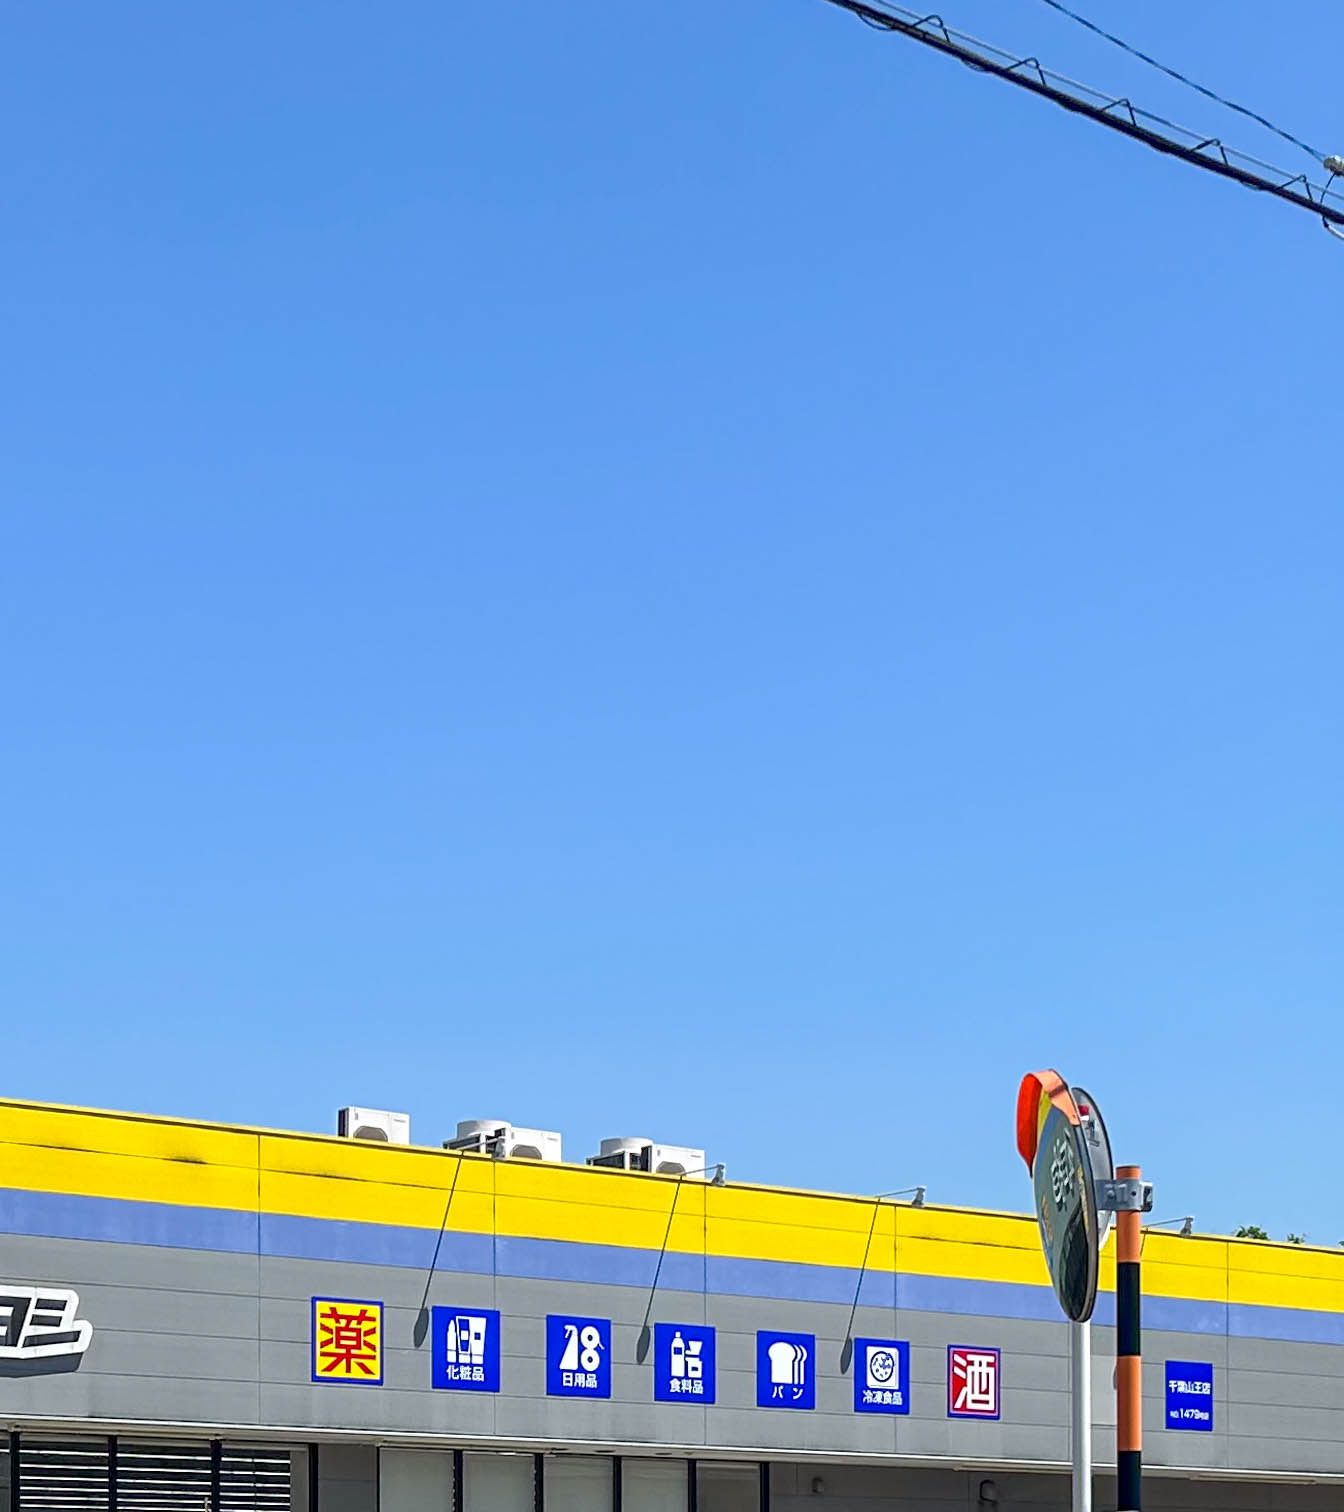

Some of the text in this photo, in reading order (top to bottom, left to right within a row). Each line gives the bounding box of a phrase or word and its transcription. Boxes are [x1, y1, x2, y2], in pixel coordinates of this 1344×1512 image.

[319, 1306, 377, 1376] 薬
[446, 1365, 485, 1382] 化粧品
[562, 1372, 598, 1389] 日用品
[953, 1353, 996, 1411] 酒
[669, 1378, 704, 1395] 食料品
[772, 1386, 804, 1400] パン
[862, 1389, 903, 1406] 冷凍食品
